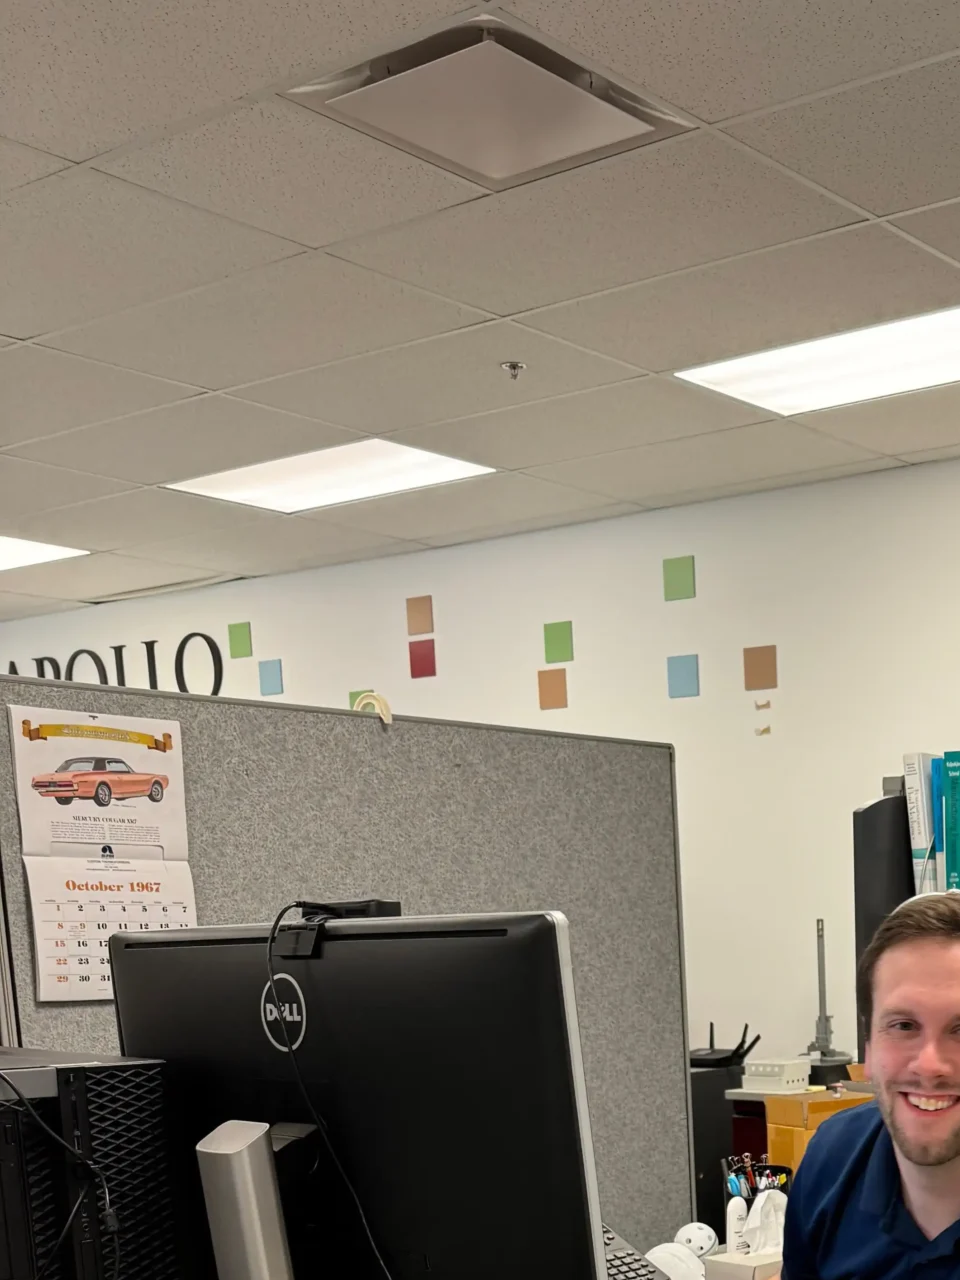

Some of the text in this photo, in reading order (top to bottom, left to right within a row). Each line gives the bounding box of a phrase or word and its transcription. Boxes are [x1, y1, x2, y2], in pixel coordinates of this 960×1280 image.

[8, 632, 223, 696] OLLO
[65, 880, 161, 893] October 1967
